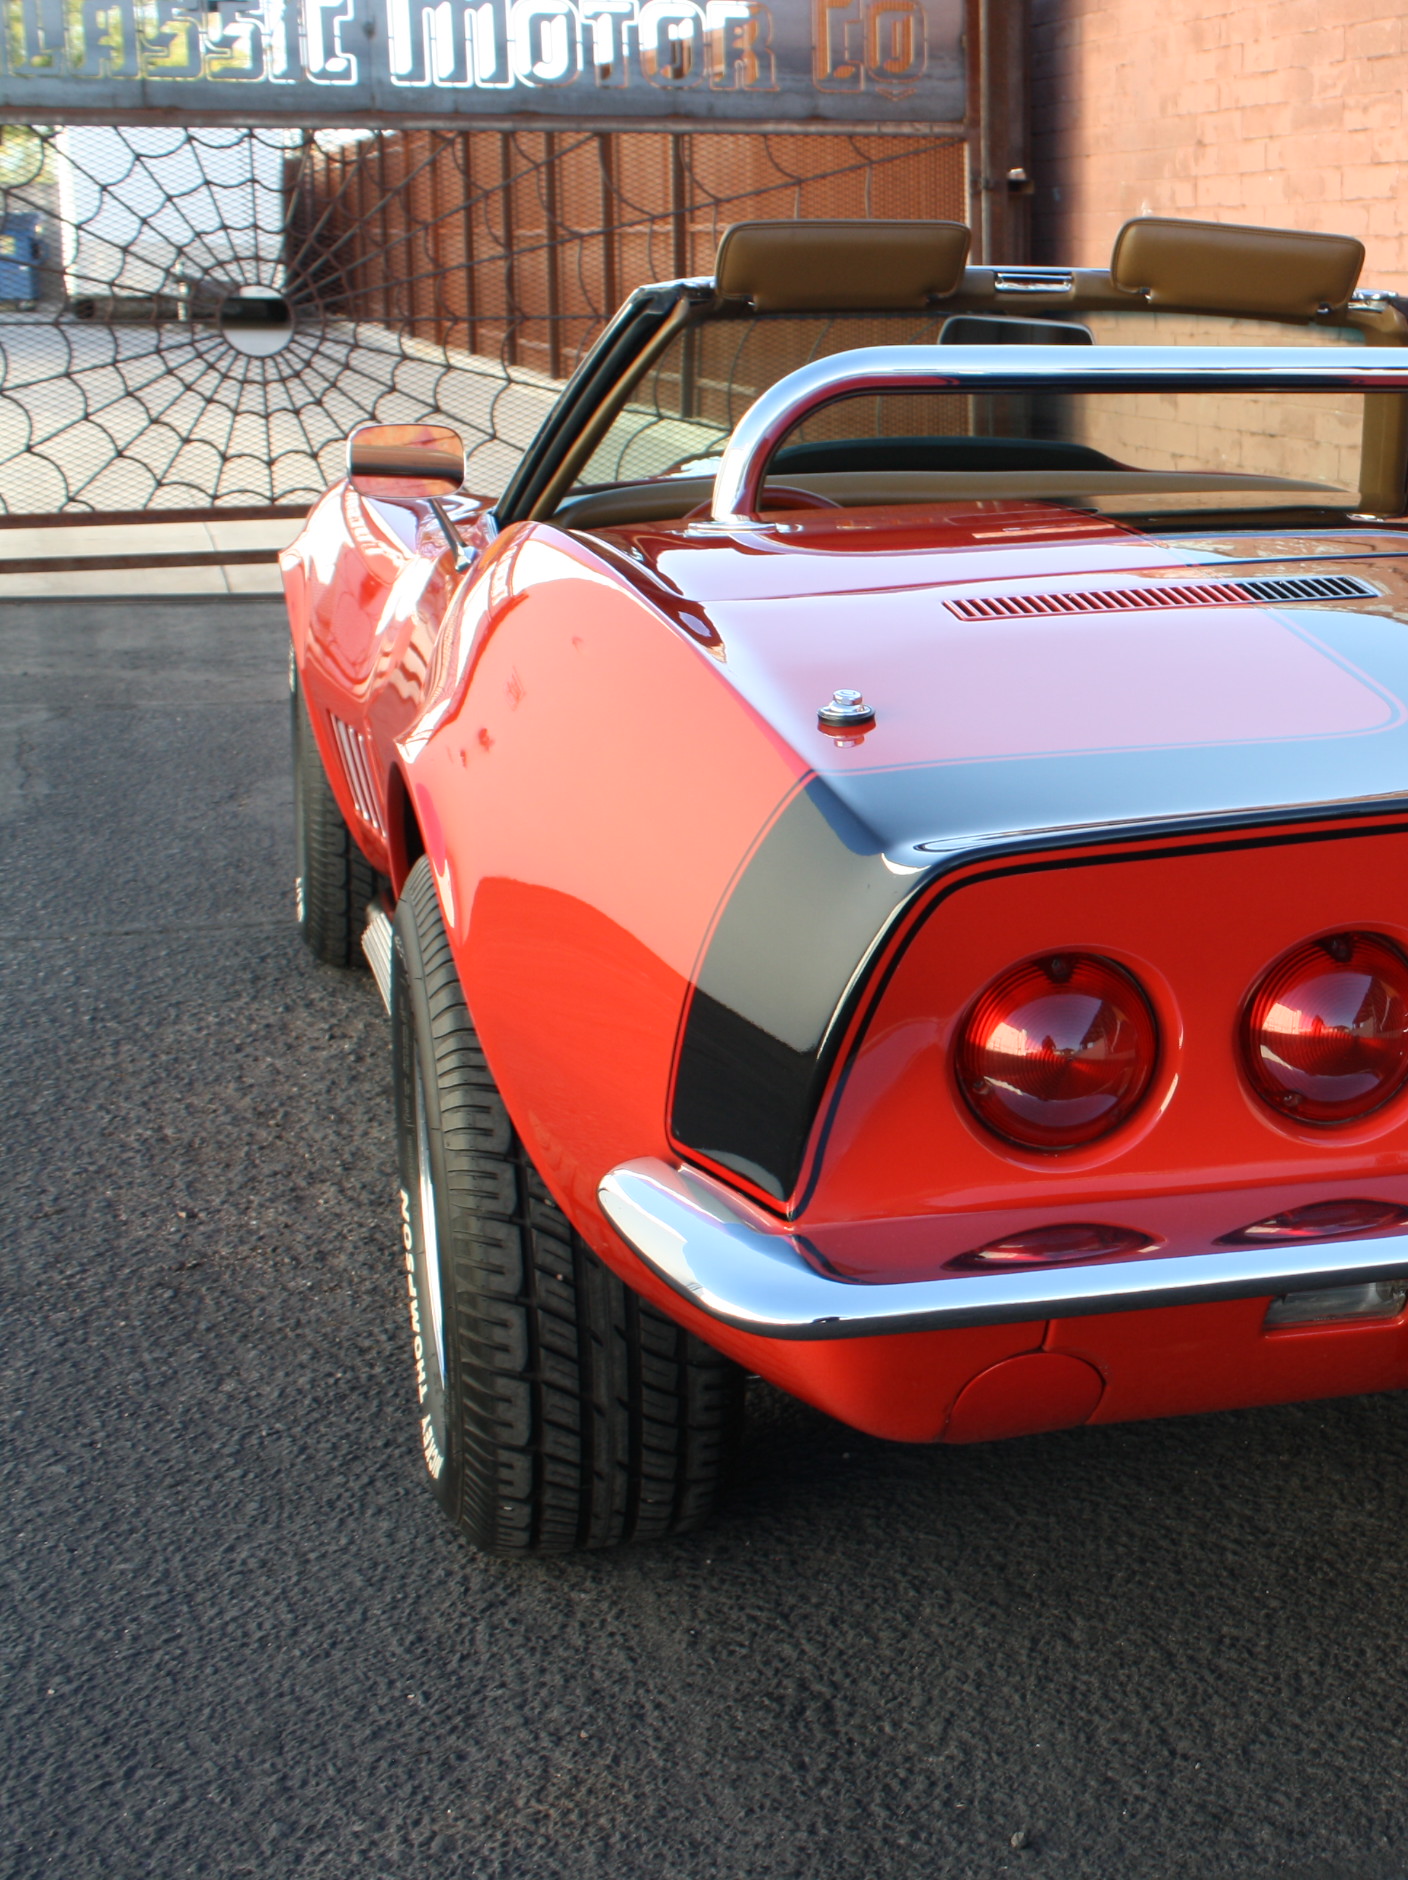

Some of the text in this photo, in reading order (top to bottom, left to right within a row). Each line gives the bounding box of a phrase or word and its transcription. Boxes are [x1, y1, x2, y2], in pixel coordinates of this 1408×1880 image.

[0, 0, 358, 86] LASSIC
[400, 1188, 445, 1480] MICKEY THOMPSON
